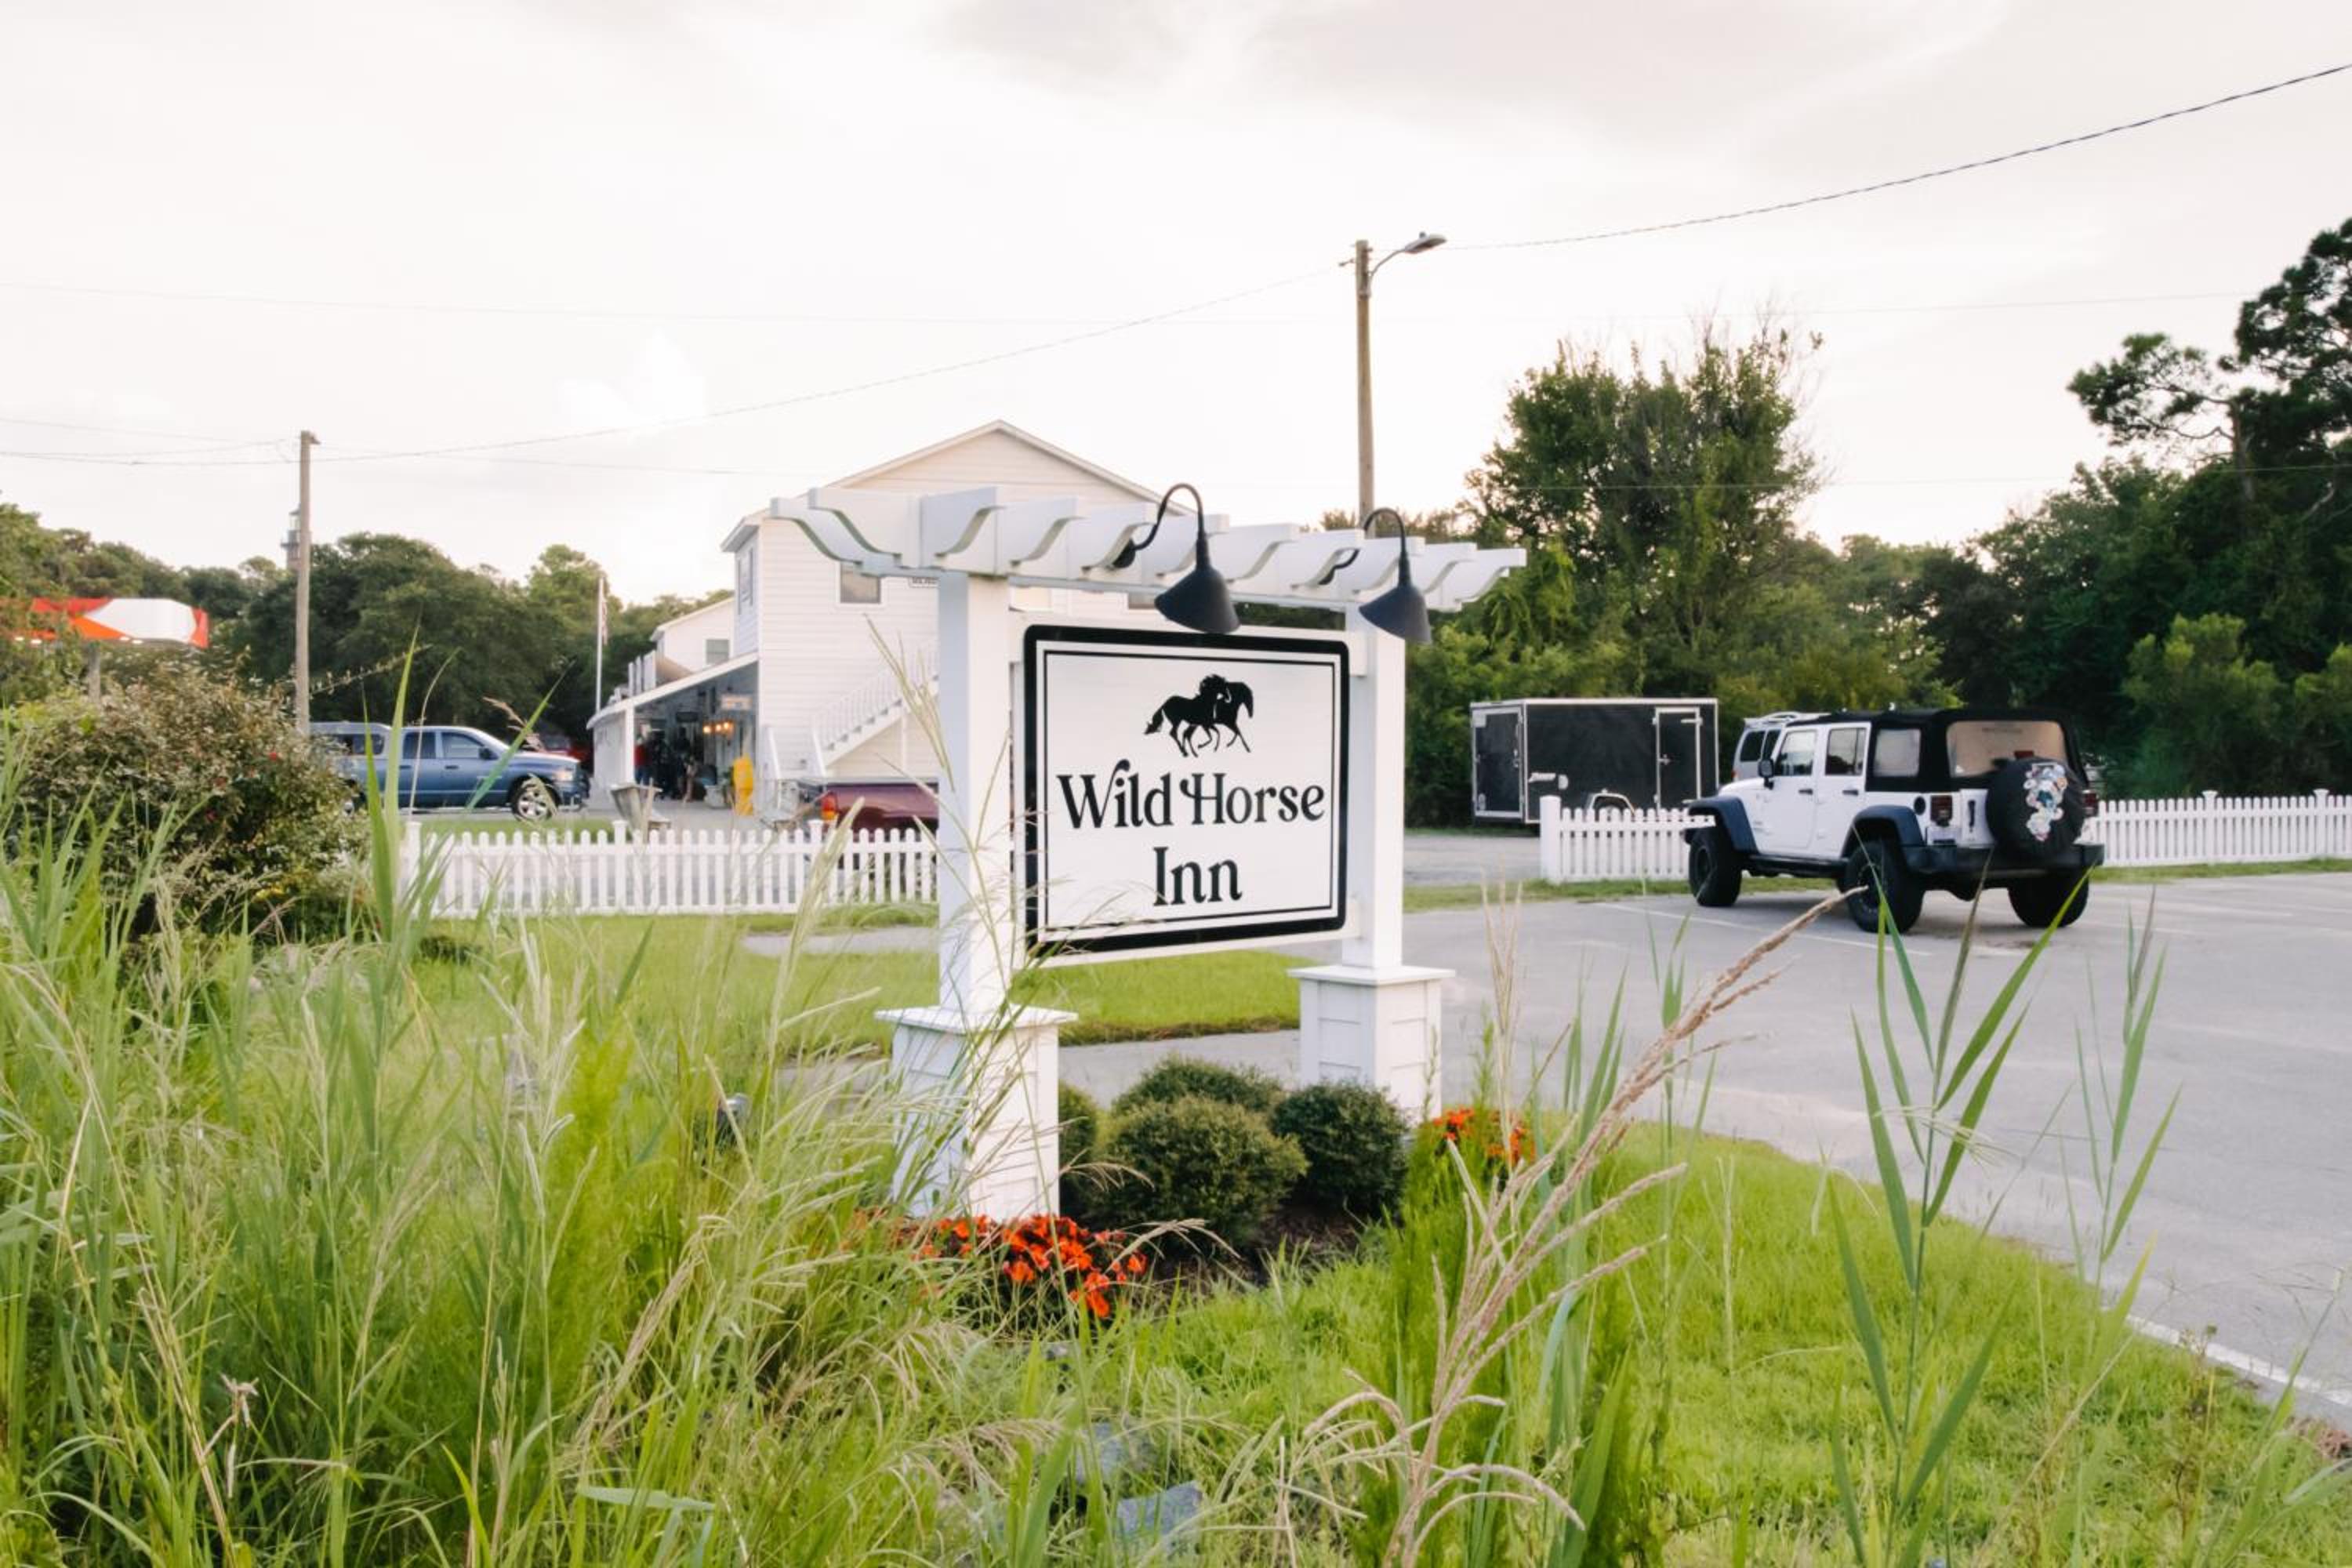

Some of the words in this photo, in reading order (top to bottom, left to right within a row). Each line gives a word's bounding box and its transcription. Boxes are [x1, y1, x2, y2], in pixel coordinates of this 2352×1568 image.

[1056, 758, 1174, 829] Wild
[1179, 772, 1325, 826] Horse
[1152, 846, 1243, 907] Inn
